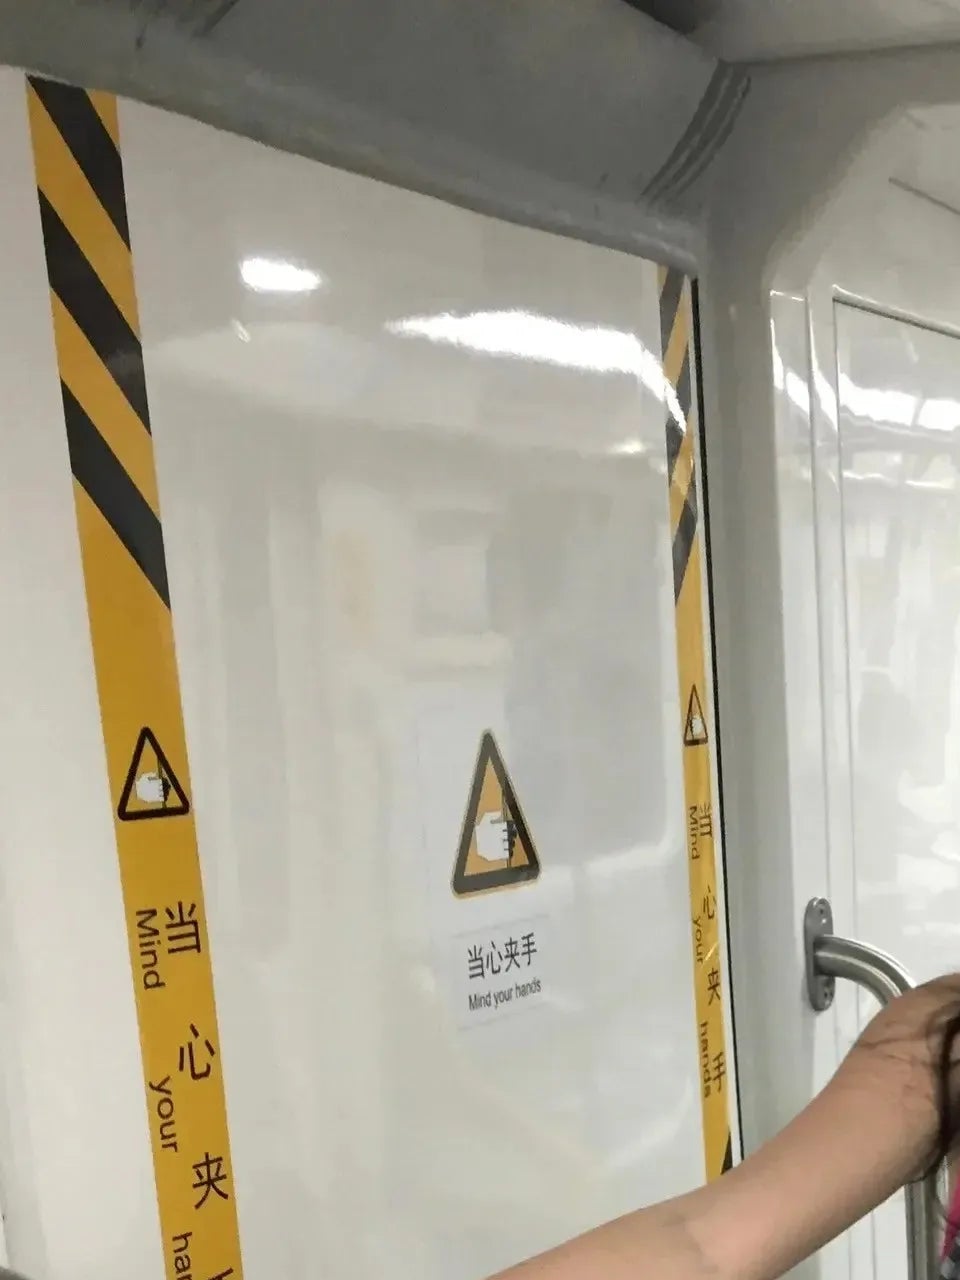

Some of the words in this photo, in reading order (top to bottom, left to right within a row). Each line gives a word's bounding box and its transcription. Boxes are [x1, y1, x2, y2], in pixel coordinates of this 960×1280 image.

[689, 806, 701, 861] Mind
[136, 908, 166, 990] Mind
[467, 932, 538, 980] 当心夹手
[468, 991, 492, 1011] Mind
[493, 987, 514, 1010] your
[515, 976, 542, 999] hands
[149, 1075, 178, 1153] your
